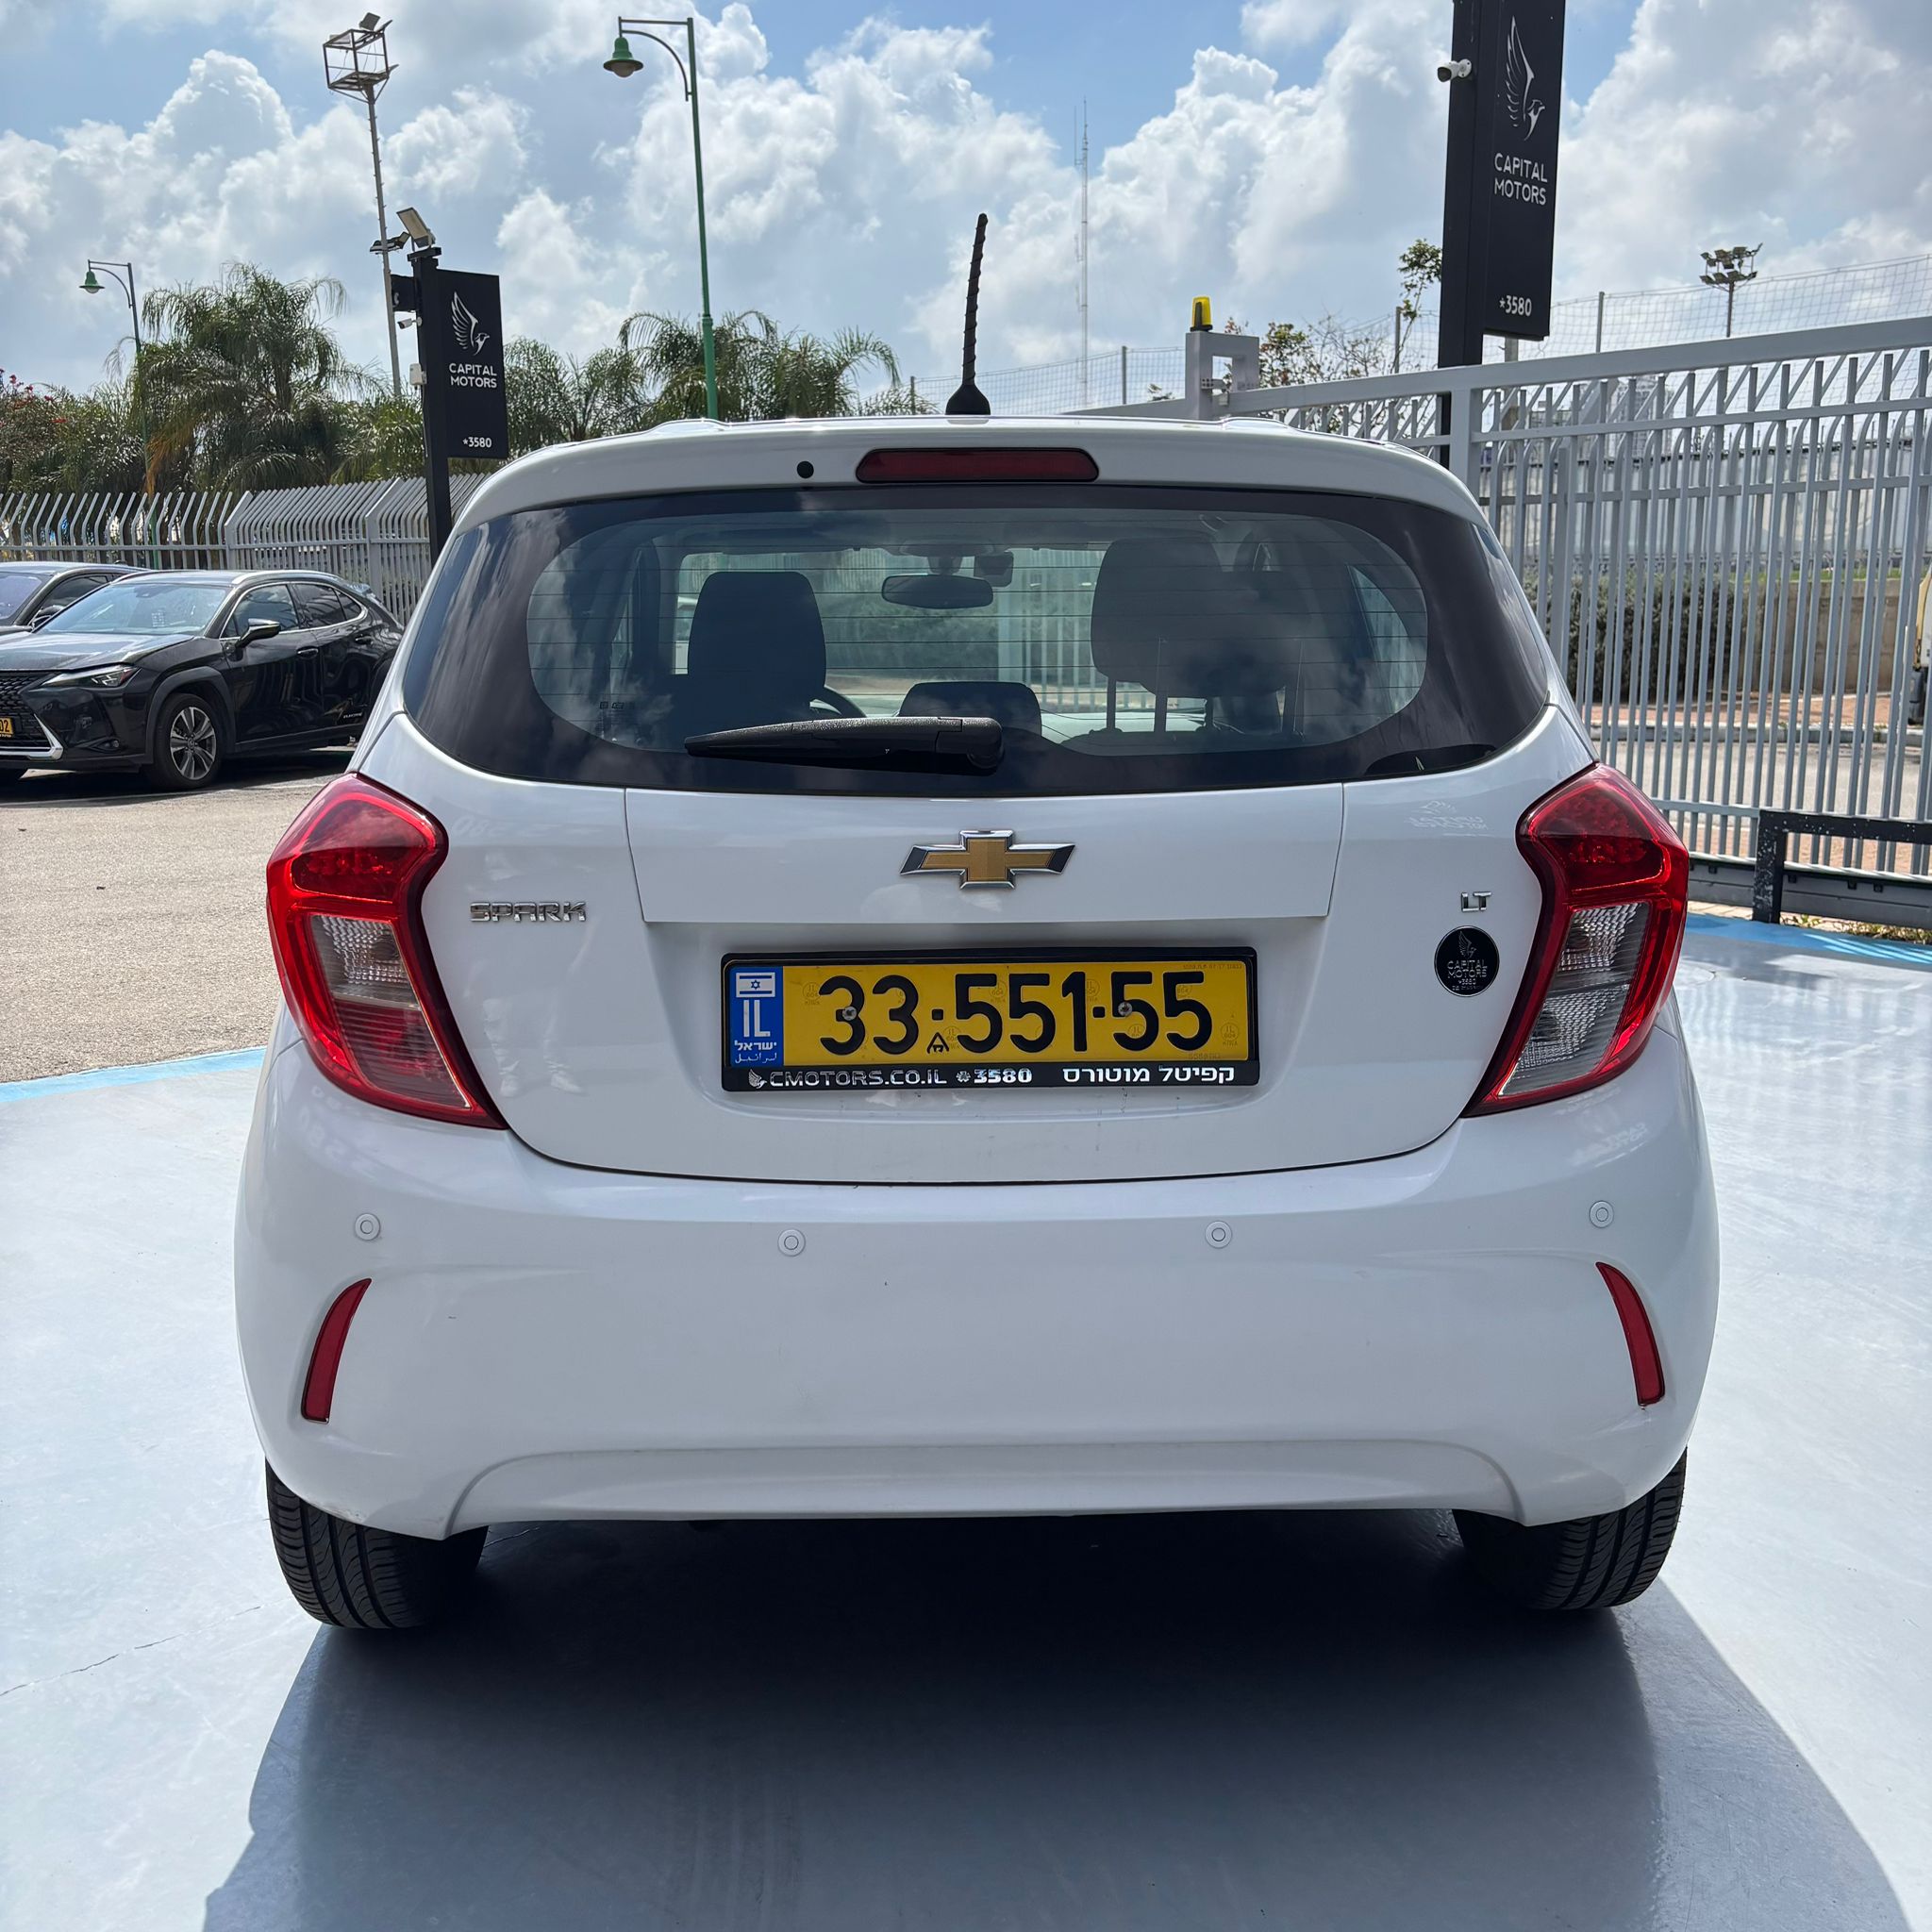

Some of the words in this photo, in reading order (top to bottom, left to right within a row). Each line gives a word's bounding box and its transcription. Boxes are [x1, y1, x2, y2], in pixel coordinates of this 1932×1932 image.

[1494, 153, 1548, 183] CAPITAL
[1494, 177, 1546, 206] MOTORS
[449, 363, 497, 376] CAPITAL
[450, 375, 497, 389] MOTORS
[1461, 891, 1491, 912] LT
[470, 902, 586, 922] SPARK
[1447, 958, 1488, 969] CAPITAL
[1447, 968, 1488, 978] MOTORS
[743, 1000, 771, 1038] IL
[734, 1040, 777, 1051] ישראל
[769, 1069, 947, 1087] CMOTORS.CO.IL
[1062, 1067, 1150, 1083] מוטורס
[1158, 1065, 1235, 1084] קפיטל
